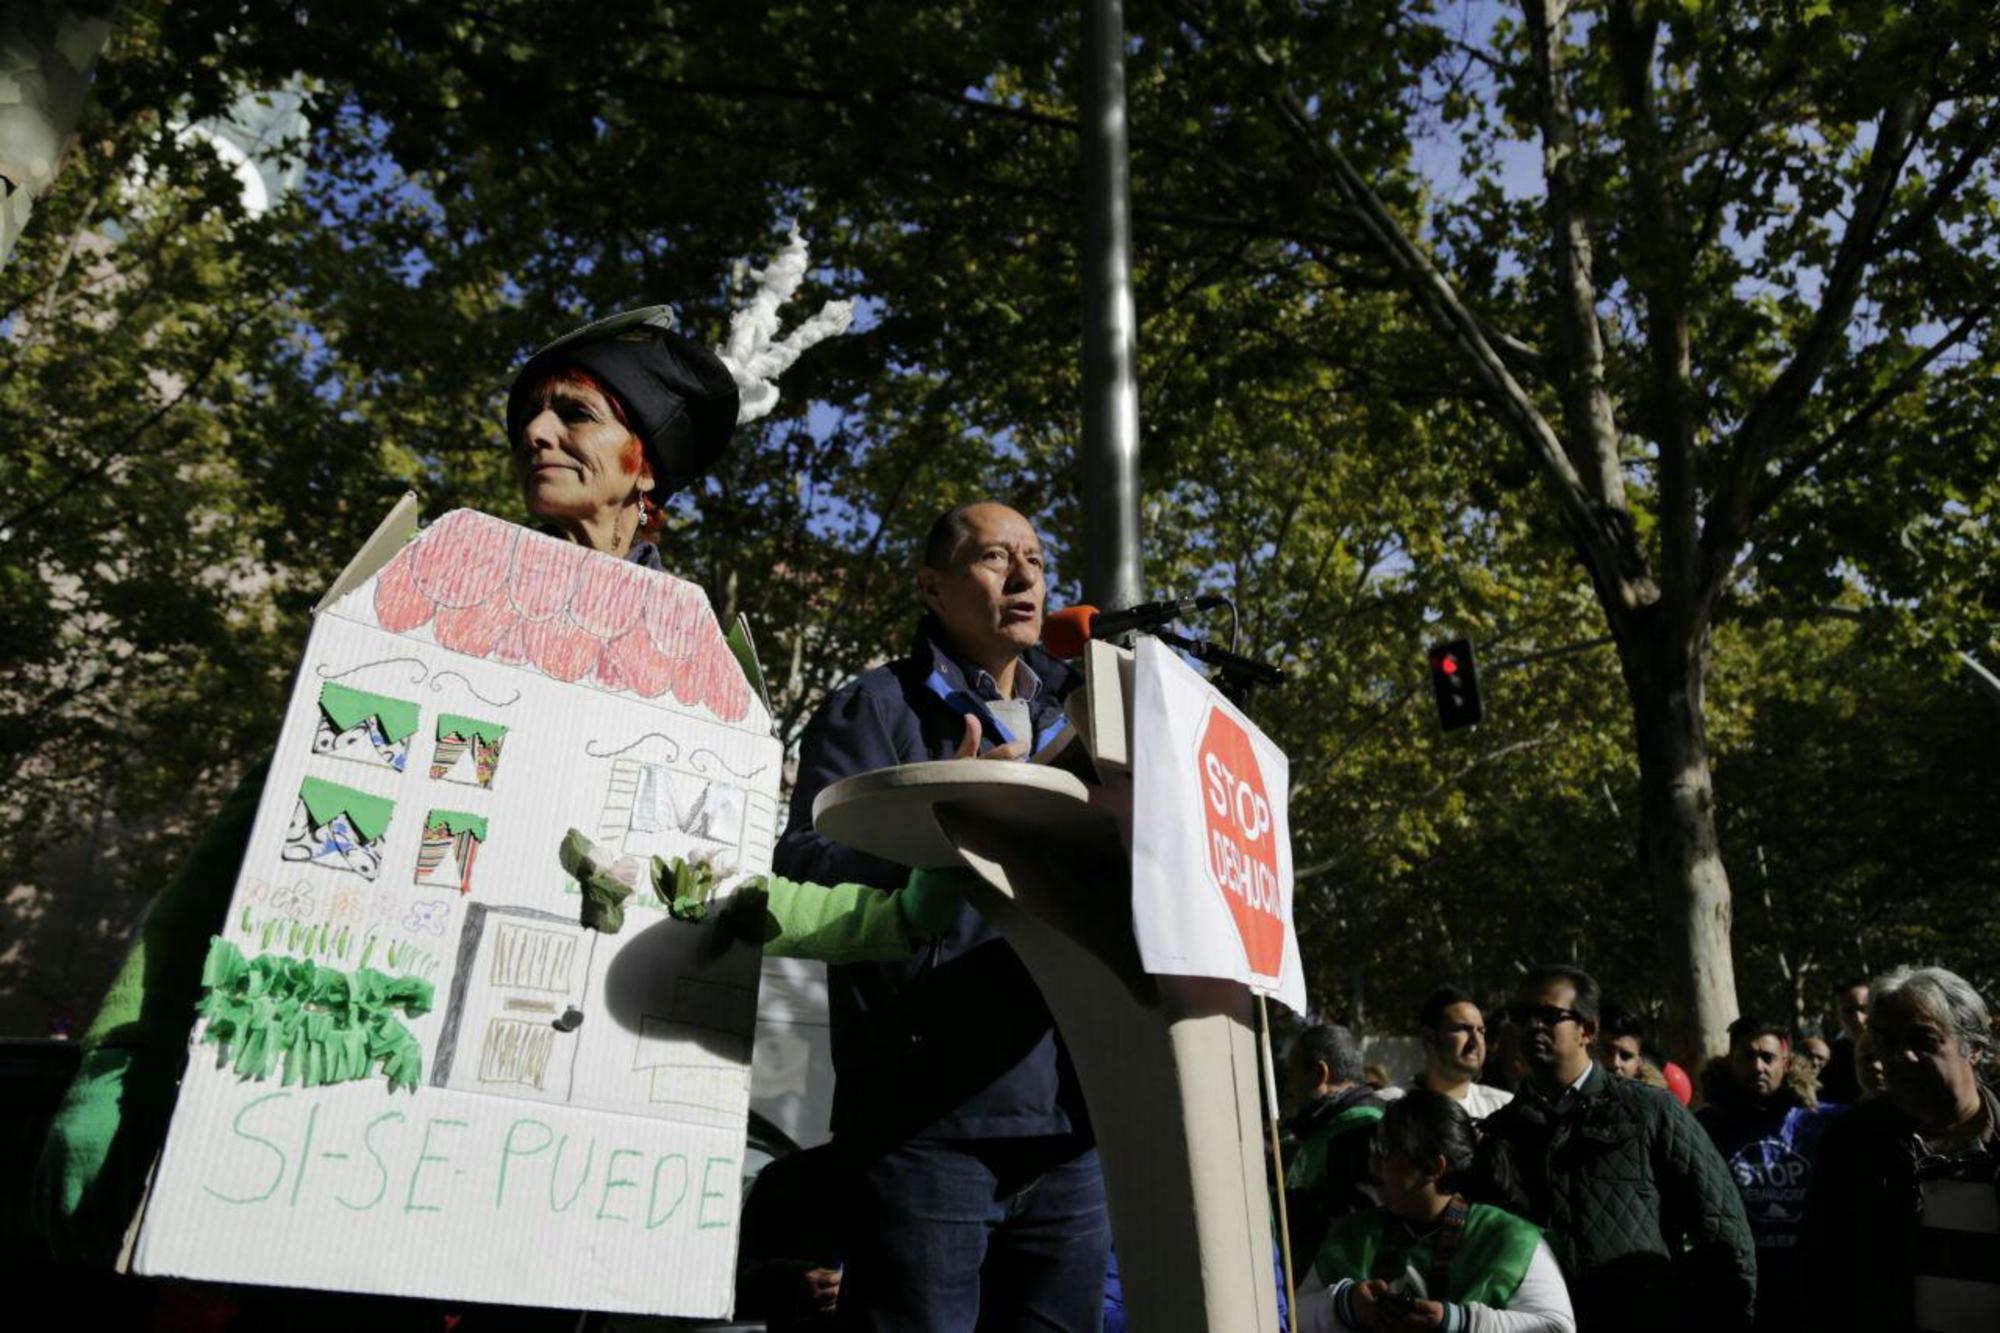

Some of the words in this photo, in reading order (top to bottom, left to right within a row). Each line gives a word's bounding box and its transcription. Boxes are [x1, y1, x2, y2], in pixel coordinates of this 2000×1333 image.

[1205, 751, 1270, 848] STOP
[496, 1118, 734, 1230] PUEDE
[1733, 1160, 1804, 1188] STOP
